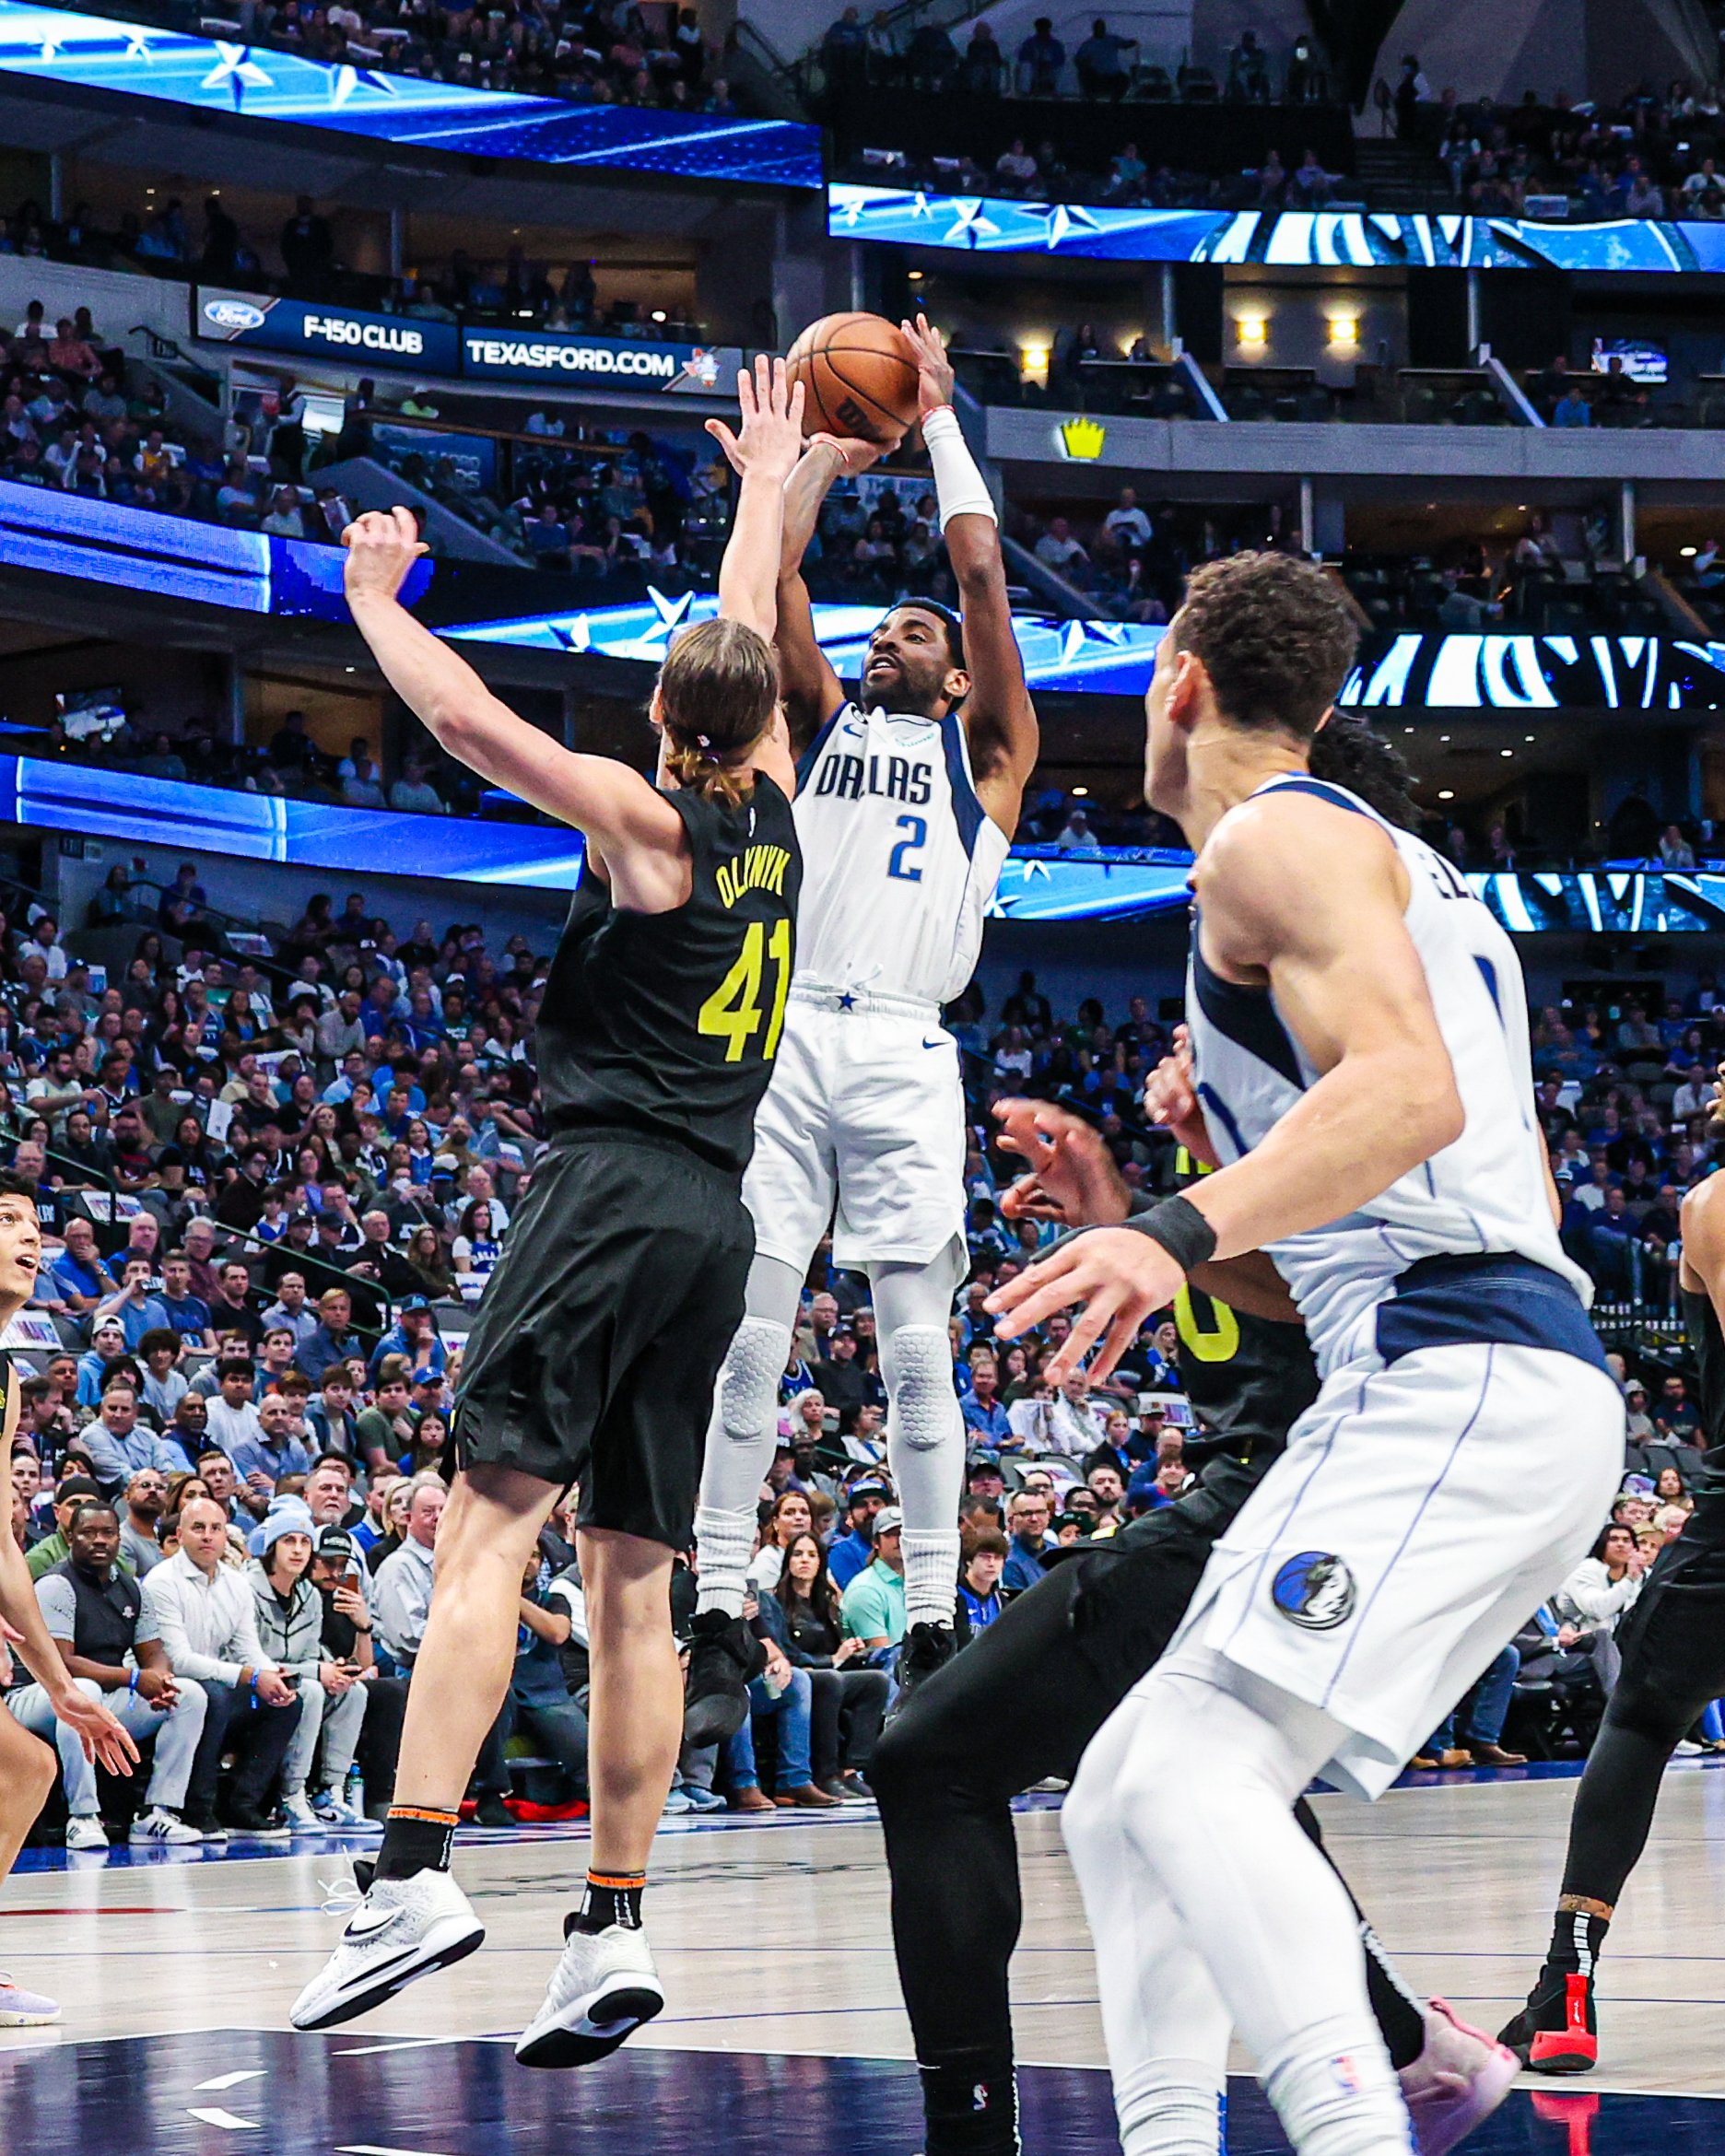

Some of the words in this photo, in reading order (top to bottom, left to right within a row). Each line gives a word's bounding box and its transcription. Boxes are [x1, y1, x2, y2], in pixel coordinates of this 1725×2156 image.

[216, 306, 254, 326] Ford
[303, 314, 362, 345] F-150
[362, 324, 423, 355] CLUB
[465, 339, 675, 377] TEXASFORD.COM
[814, 753, 933, 805] DALAS
[886, 814, 928, 884] 2
[716, 844, 792, 909] OLYNYK
[697, 919, 791, 1063] 41
